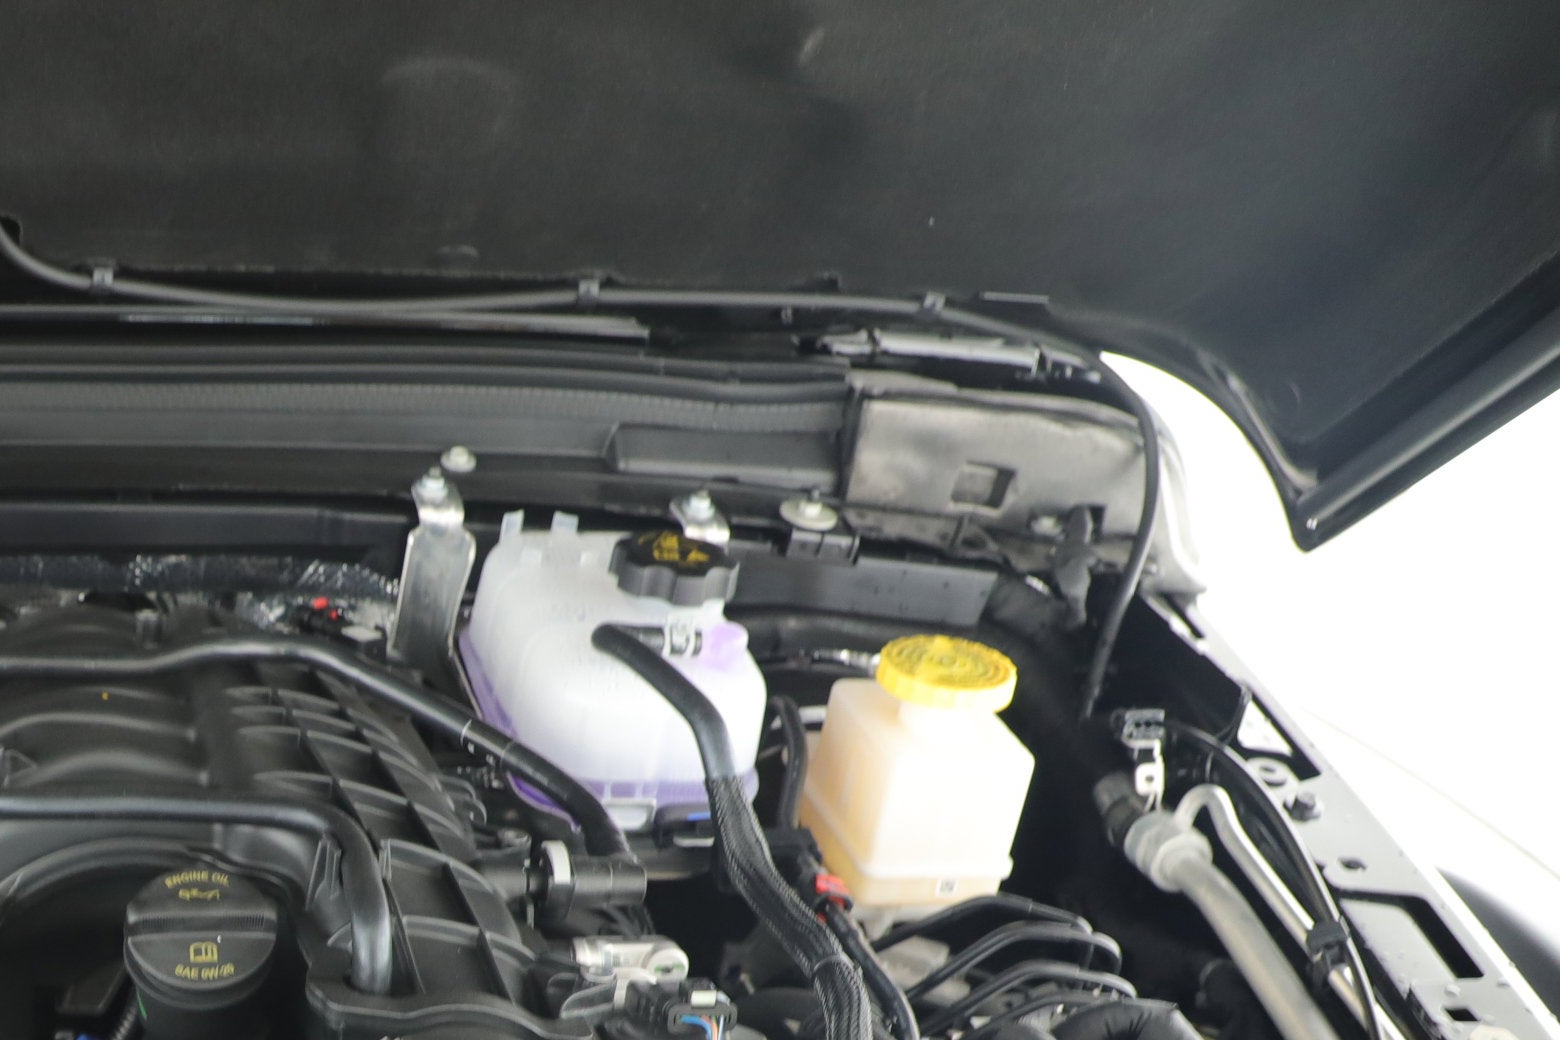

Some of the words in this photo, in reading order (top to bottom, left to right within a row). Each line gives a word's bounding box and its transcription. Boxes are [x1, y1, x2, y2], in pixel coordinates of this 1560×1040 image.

[165, 870, 209, 889] ENGINE
[212, 872, 230, 888] OIL
[175, 964, 199, 980] SAE
